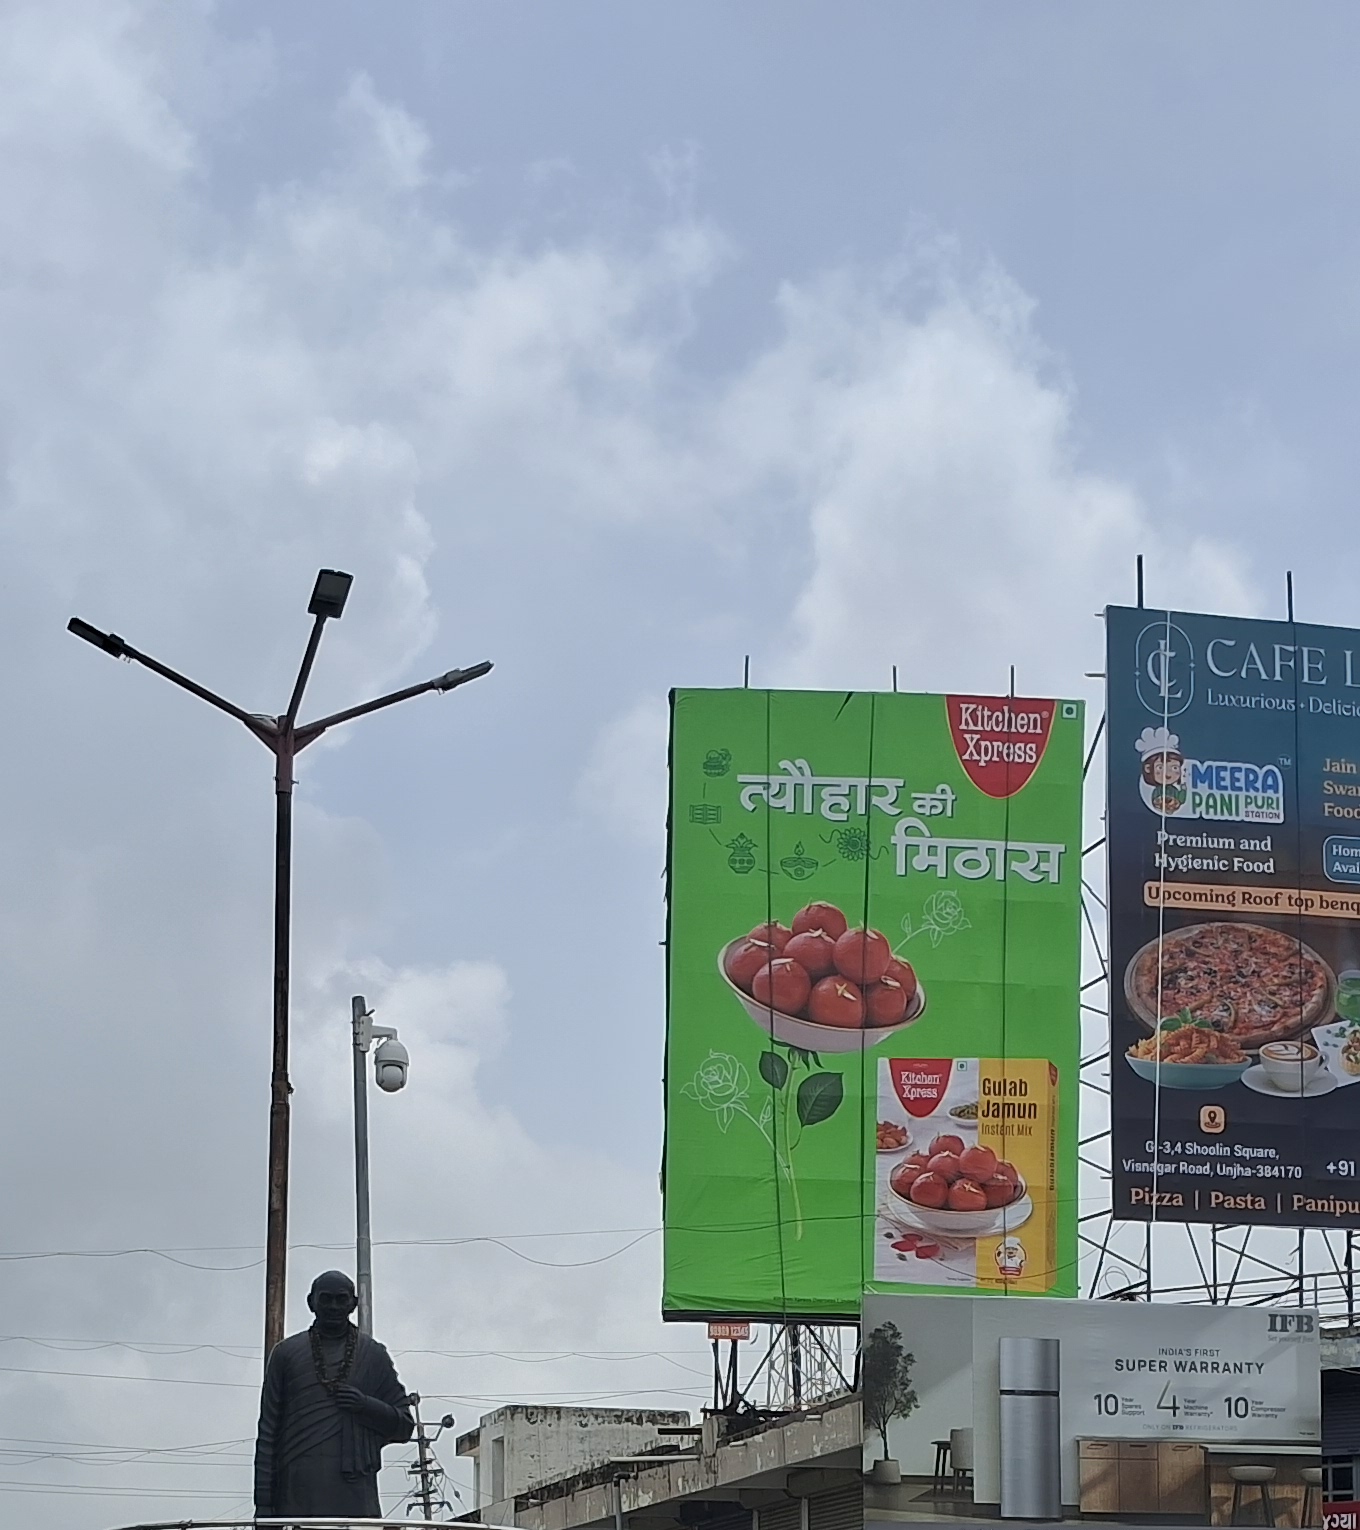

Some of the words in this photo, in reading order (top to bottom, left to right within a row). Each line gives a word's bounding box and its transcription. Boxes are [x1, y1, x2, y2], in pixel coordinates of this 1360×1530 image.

[1206, 638, 1328, 685] CAFE
[1208, 689, 1296, 711] Luxurious
[959, 703, 1042, 734] Kitchen
[962, 733, 1037, 766] Xpress
[1322, 758, 1357, 775] Jain
[1191, 764, 1280, 794] MEERA
[736, 758, 906, 821] त्यौहार
[911, 783, 957, 818] की
[1191, 791, 1240, 817] PANI
[1244, 794, 1280, 811] PURI
[1244, 810, 1281, 820] STATION
[891, 816, 1066, 883] मिठास
[1156, 830, 1235, 849] Premium
[1239, 836, 1272, 851] and
[1154, 852, 1230, 873] Hygienic
[1233, 857, 1275, 873] Food
[1147, 886, 1237, 908] Upcoming
[1241, 891, 1283, 906] Roof
[1287, 894, 1315, 911] top
[901, 1072, 940, 1085] Kitchen
[982, 1078, 1028, 1097] Gulab
[902, 1085, 938, 1100] Xpress
[982, 1100, 1037, 1119] Jamun
[981, 1123, 1015, 1136] Instant
[1017, 1123, 1033, 1136] Mix
[1185, 1142, 1231, 1157] Shoolin
[1233, 1144, 1280, 1161] Square,
[1122, 1159, 1177, 1176] Visnagar
[1179, 1162, 1214, 1177] Road,
[1216, 1163, 1302, 1179] Unjha-384170
[1326, 1160, 1355, 1176] +91
[1130, 1187, 1184, 1206] Pizza
[1210, 1191, 1267, 1210] Pasta
[1268, 1314, 1314, 1333] IFB
[1158, 1347, 1192, 1358] INDIA'S
[1194, 1348, 1221, 1358] FIRST
[1114, 1359, 1168, 1373] SUPER
[1174, 1360, 1265, 1375] WARRANTY
[1094, 1393, 1119, 1416] 10
[1156, 1380, 1180, 1417] 4
[1224, 1396, 1249, 1419] 10
[1251, 1405, 1286, 1413] Compressor
[1143, 1423, 1160, 1432] ONLY
[1161, 1424, 1172, 1432] ON
[1172, 1423, 1185, 1431] IFB
[1185, 1424, 1239, 1432] REFRIGERATORS
